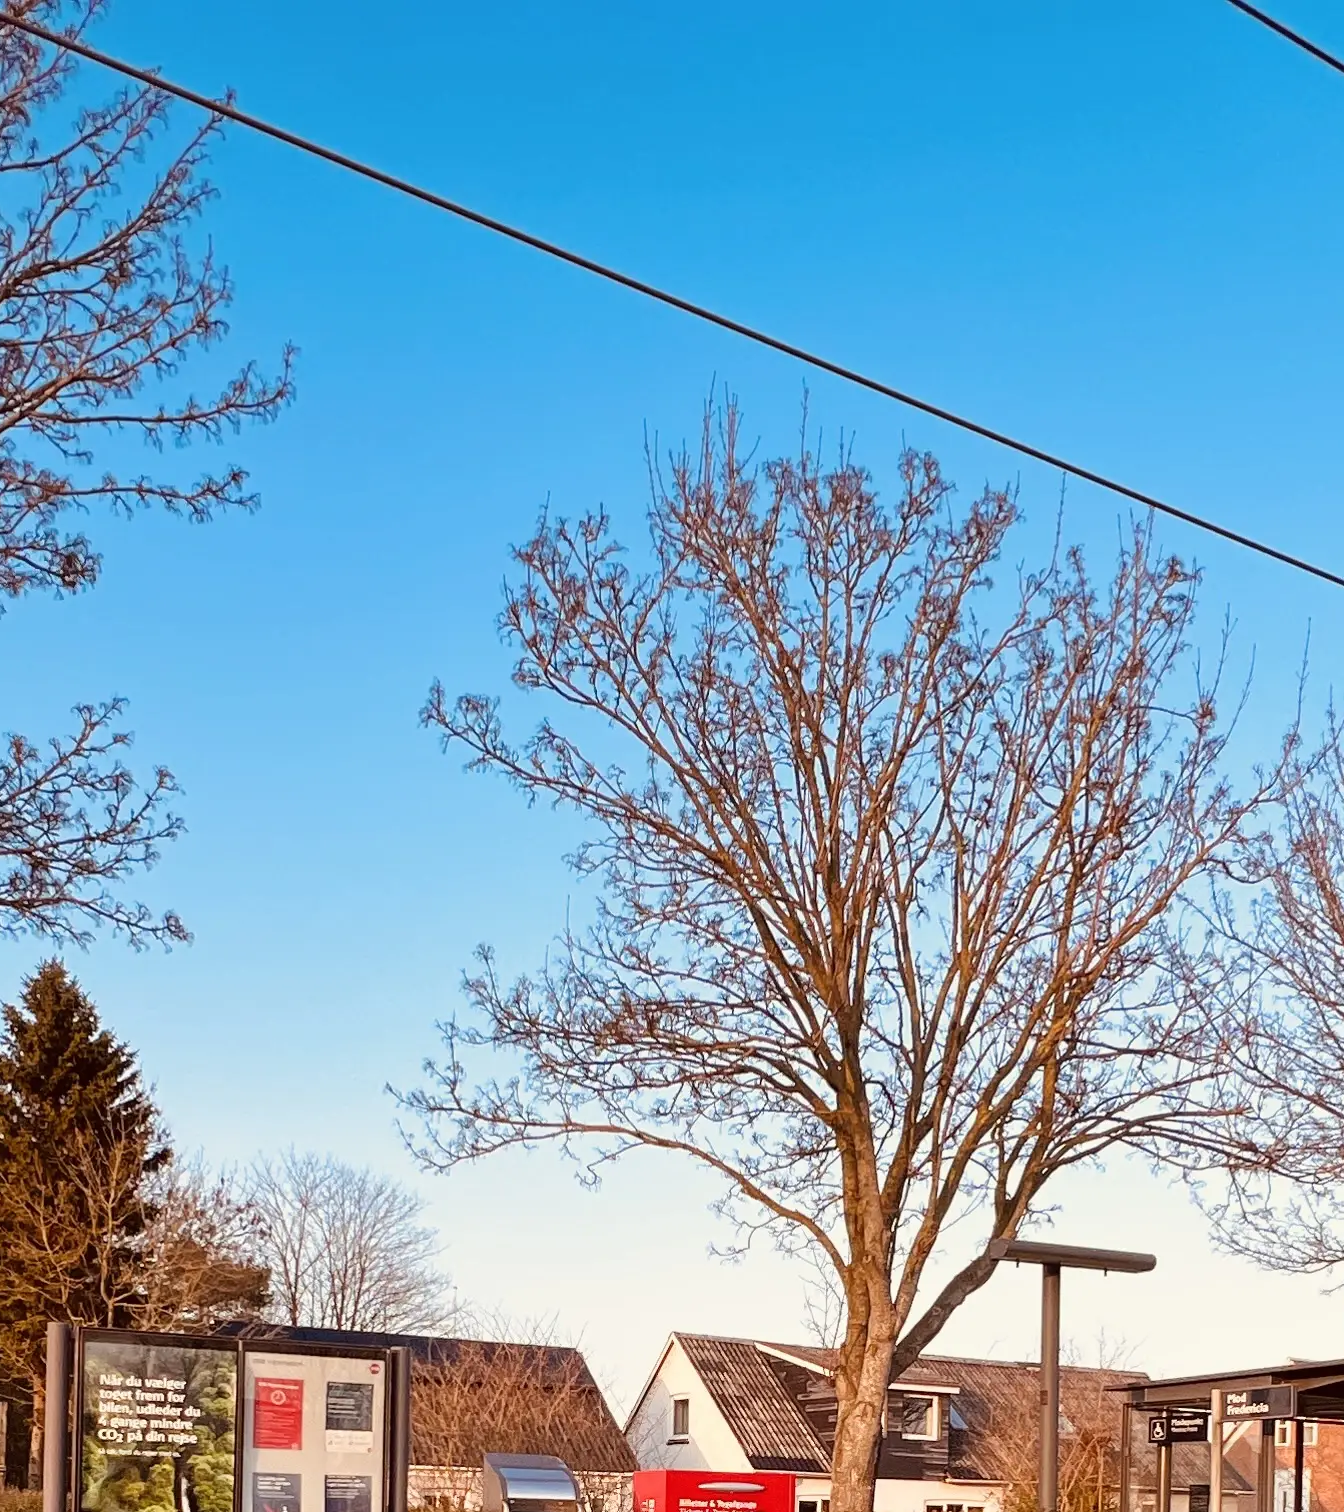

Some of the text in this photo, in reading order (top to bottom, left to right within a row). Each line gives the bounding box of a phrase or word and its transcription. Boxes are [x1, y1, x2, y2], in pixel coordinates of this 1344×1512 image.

[126, 1375, 142, 1387] du
[99, 1389, 186, 1403] toget frem for
[184, 1405, 201, 1417] du
[97, 1416, 194, 1430] 4 gange mindre
[145, 1430, 166, 1442] din
